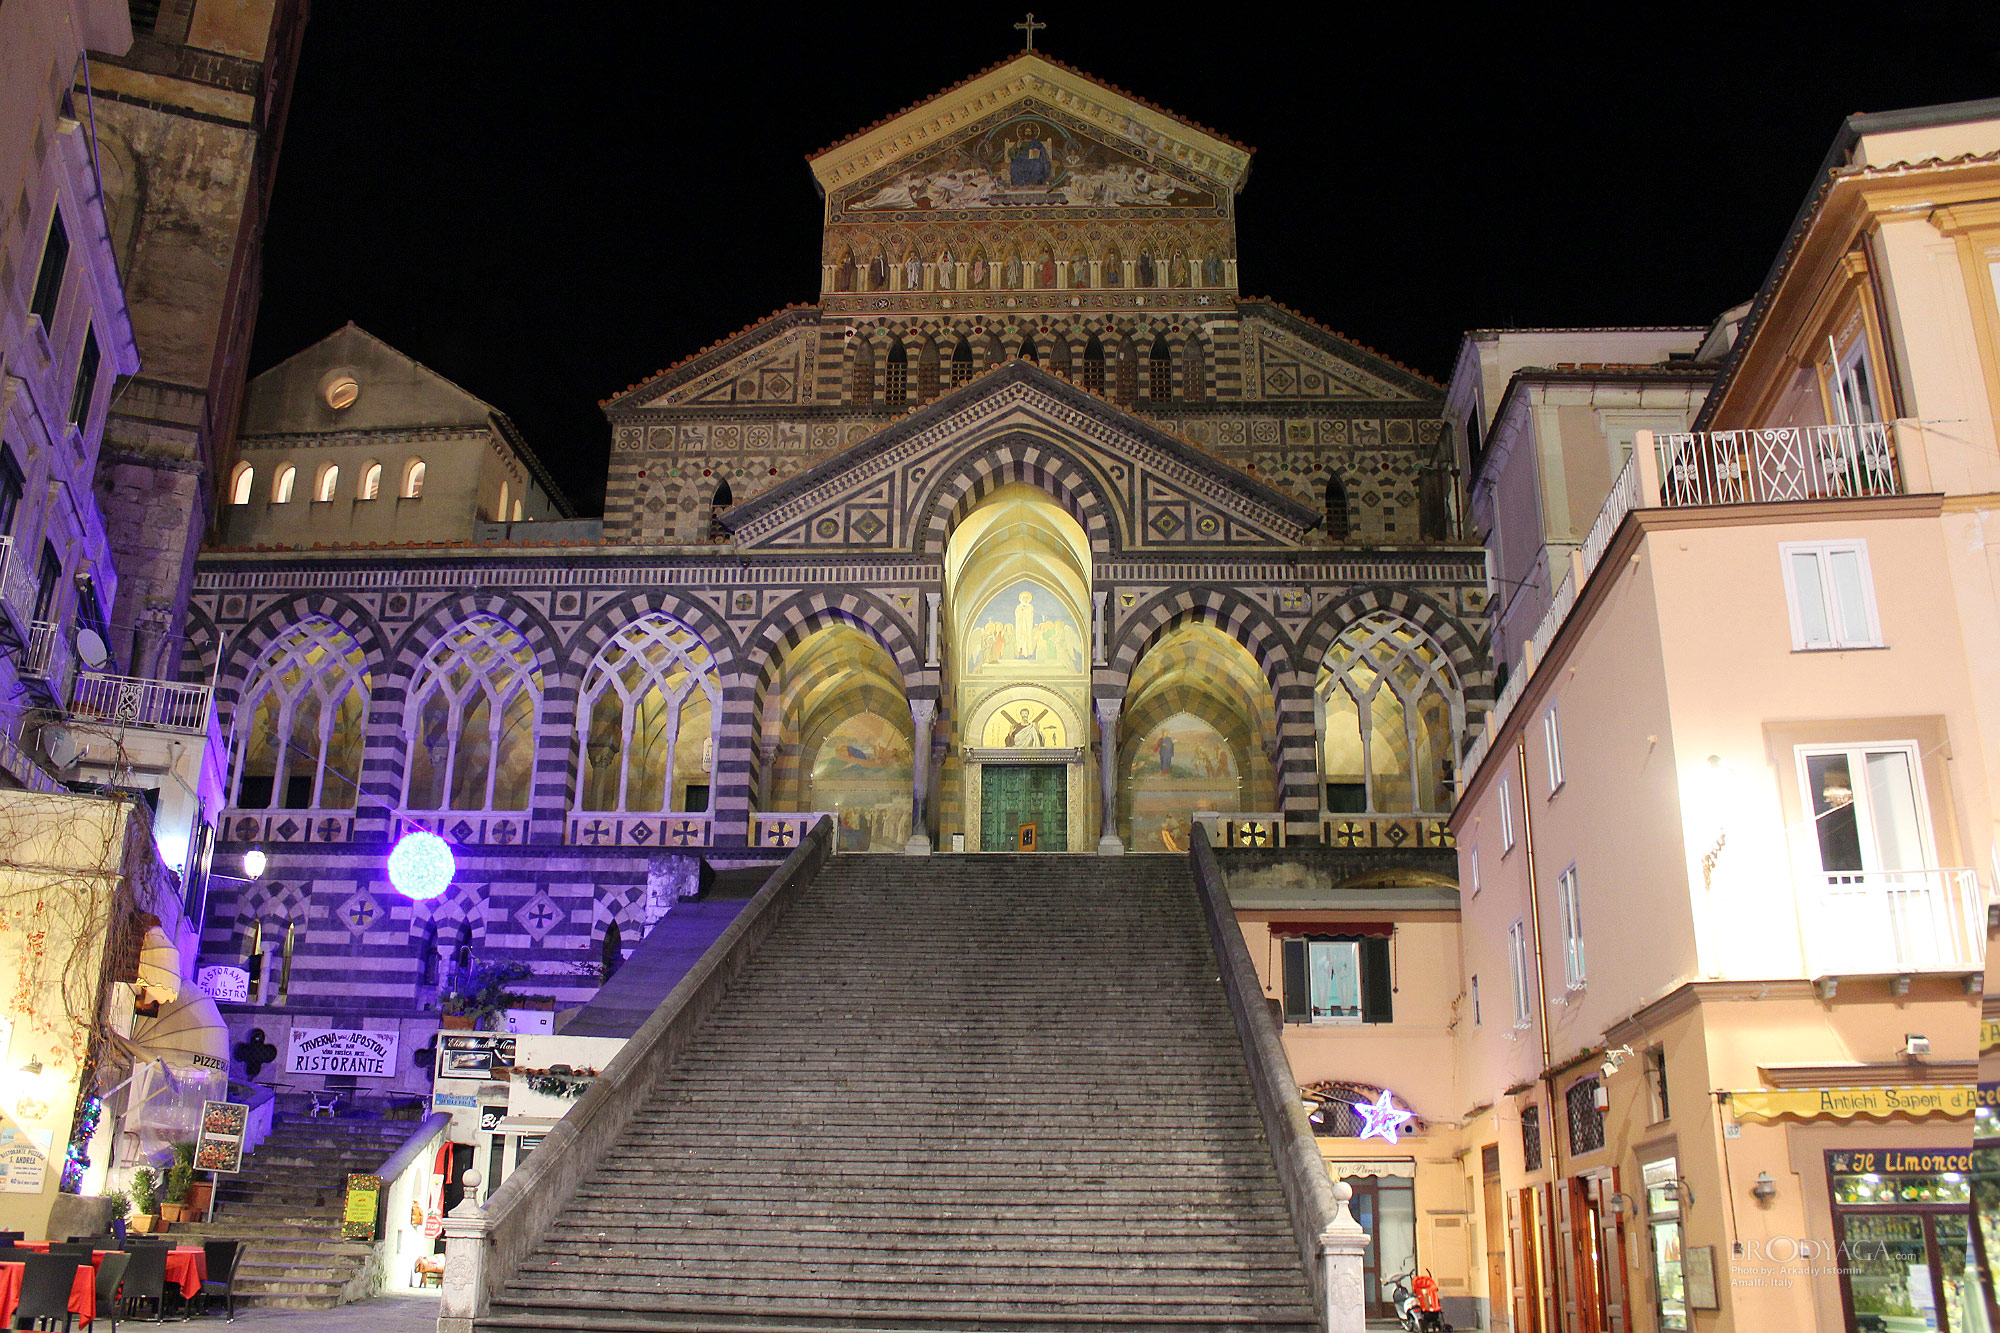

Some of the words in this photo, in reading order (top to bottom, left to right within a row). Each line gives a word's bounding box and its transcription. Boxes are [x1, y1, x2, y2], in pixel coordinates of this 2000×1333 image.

[200, 967, 245, 989] RISTORANTE
[200, 986, 247, 999] HIOSTRO
[299, 1032, 338, 1053] TAVERNA
[349, 1032, 388, 1058] APOSTOLI
[295, 1055, 385, 1074] RISTORANTE
[1820, 1091, 1877, 1110] Antichi
[1885, 1089, 1942, 1109] Sapori
[1852, 1153, 1875, 1172] Il
